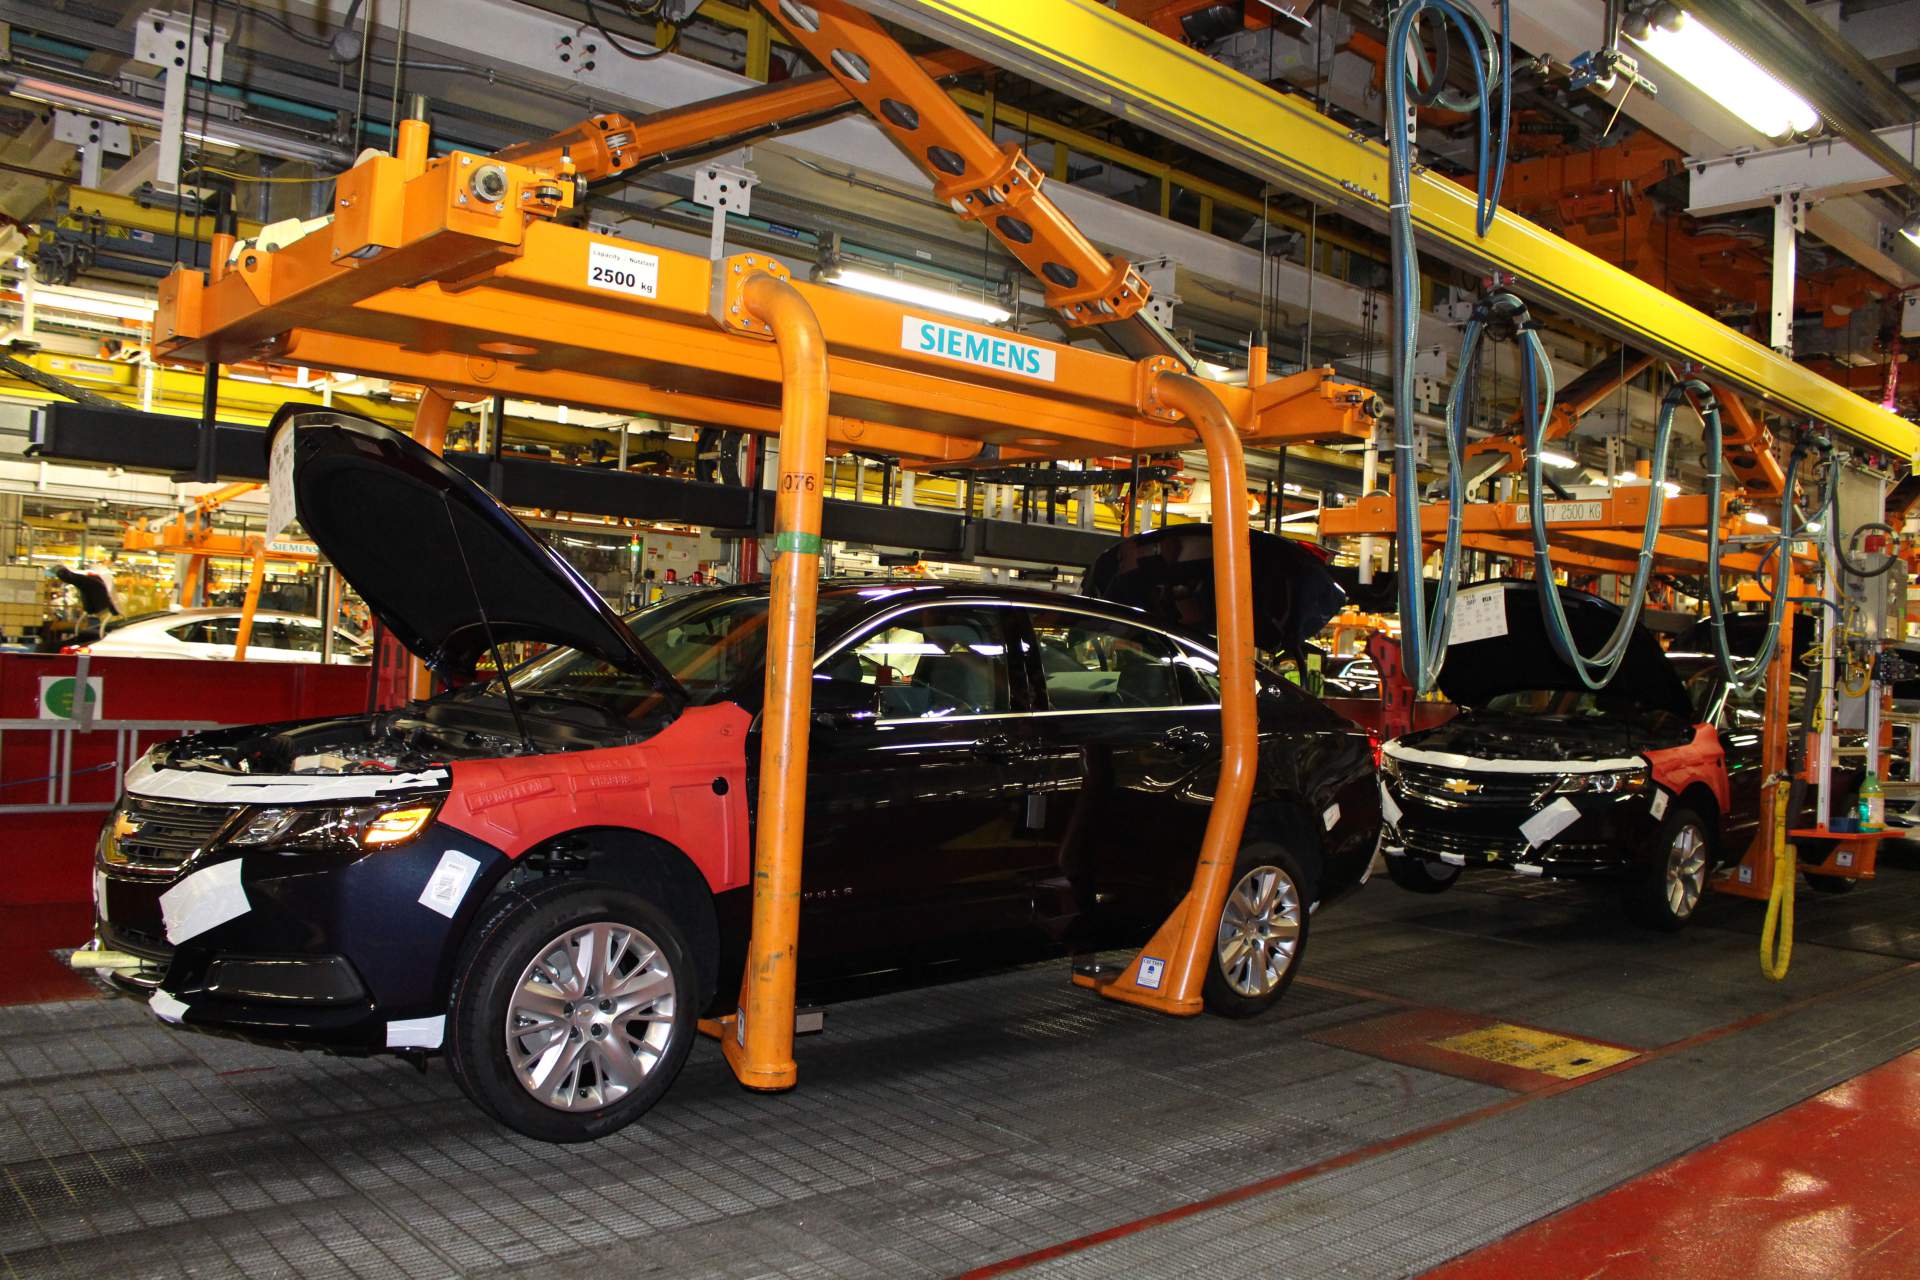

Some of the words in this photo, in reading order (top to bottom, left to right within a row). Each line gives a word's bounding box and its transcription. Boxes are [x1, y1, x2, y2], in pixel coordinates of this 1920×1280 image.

[592, 266, 635, 287] 2500
[641, 282, 653, 294] kg
[919, 323, 1040, 374] SIEMENS
[784, 474, 815, 491] 076
[1561, 503, 1584, 520] 2500
[1589, 503, 1601, 519] KG
[272, 543, 320, 553] SIEMENS
